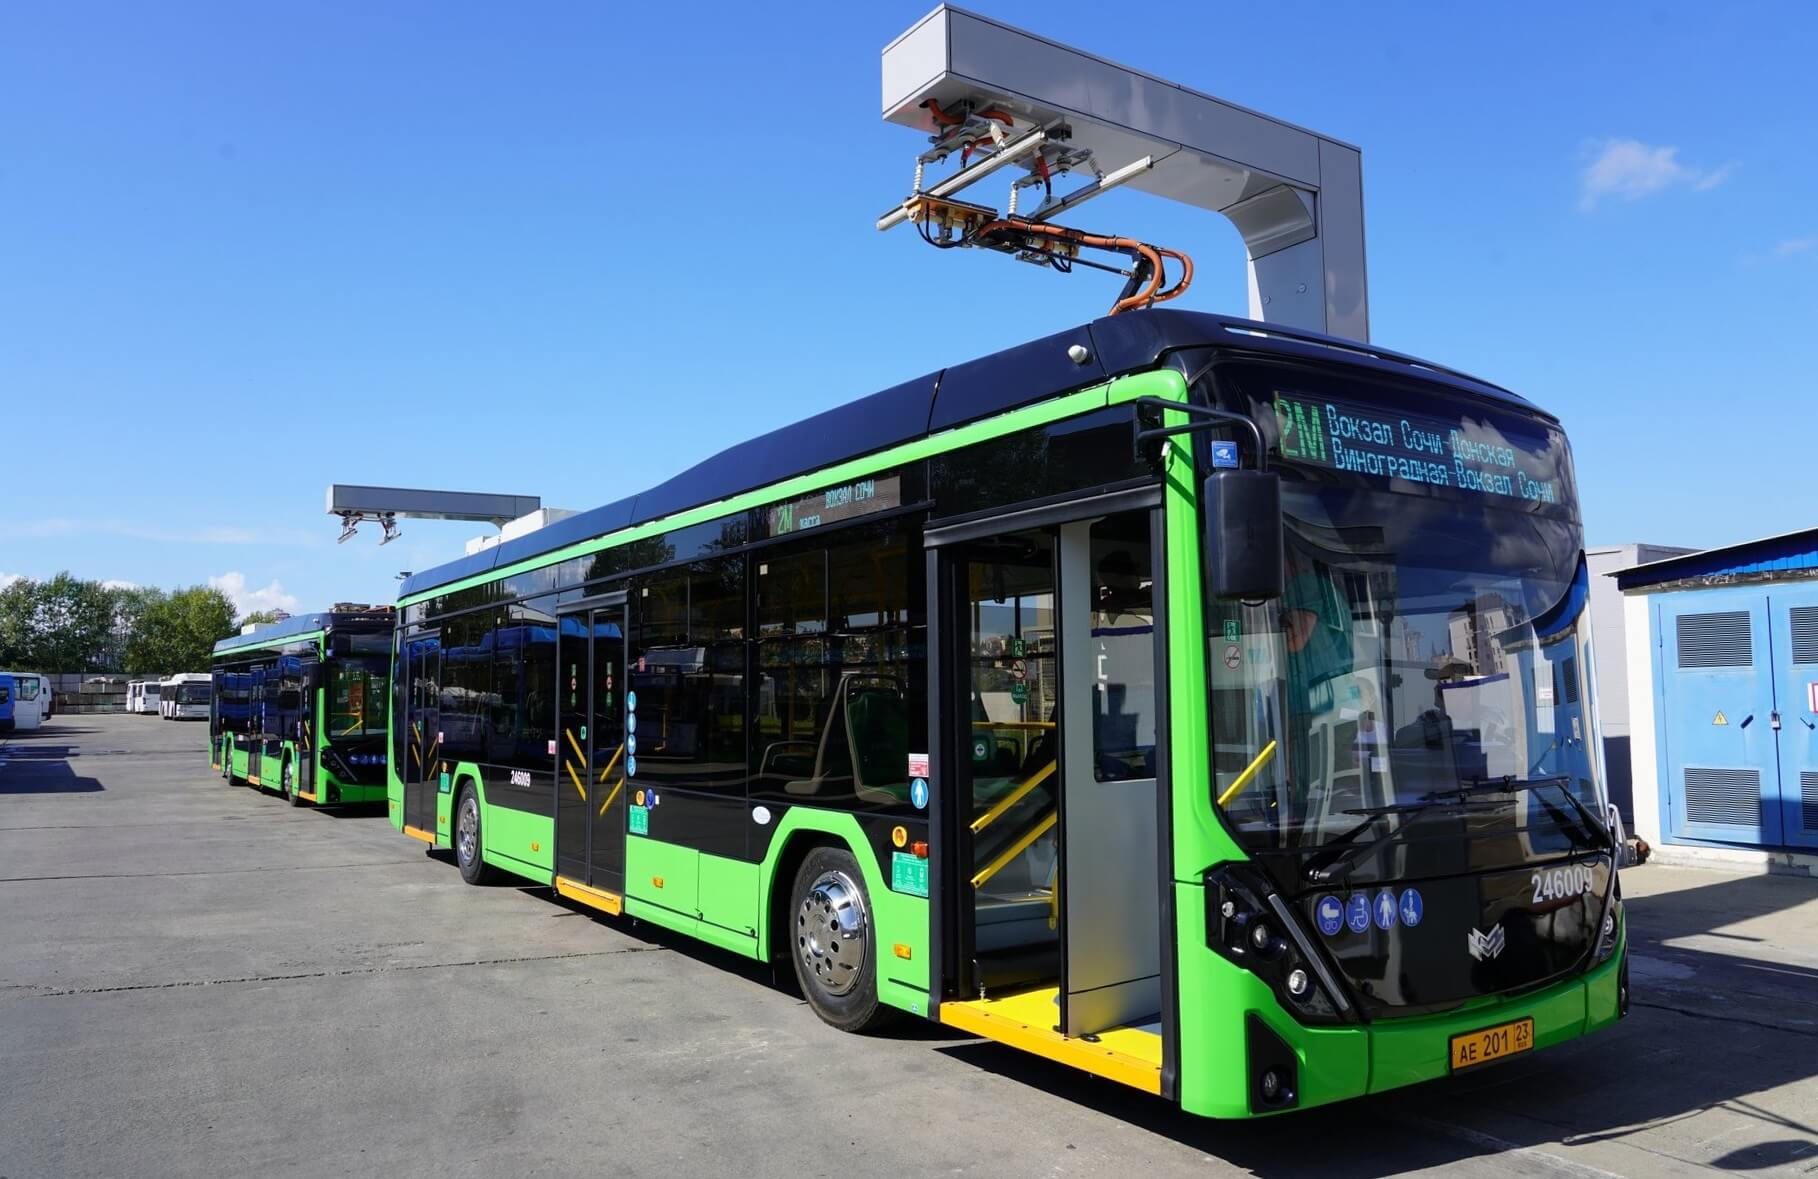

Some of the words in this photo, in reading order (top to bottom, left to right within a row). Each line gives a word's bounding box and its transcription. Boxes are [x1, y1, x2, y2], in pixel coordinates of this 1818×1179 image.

[1326, 403, 1394, 447] Вокзал
[1517, 471, 1555, 504] Сочи
[510, 769, 531, 788] 246009
[1531, 866, 1593, 904] 246009
[1483, 1029, 1509, 1057] 201
[1515, 1023, 1529, 1042] 23
